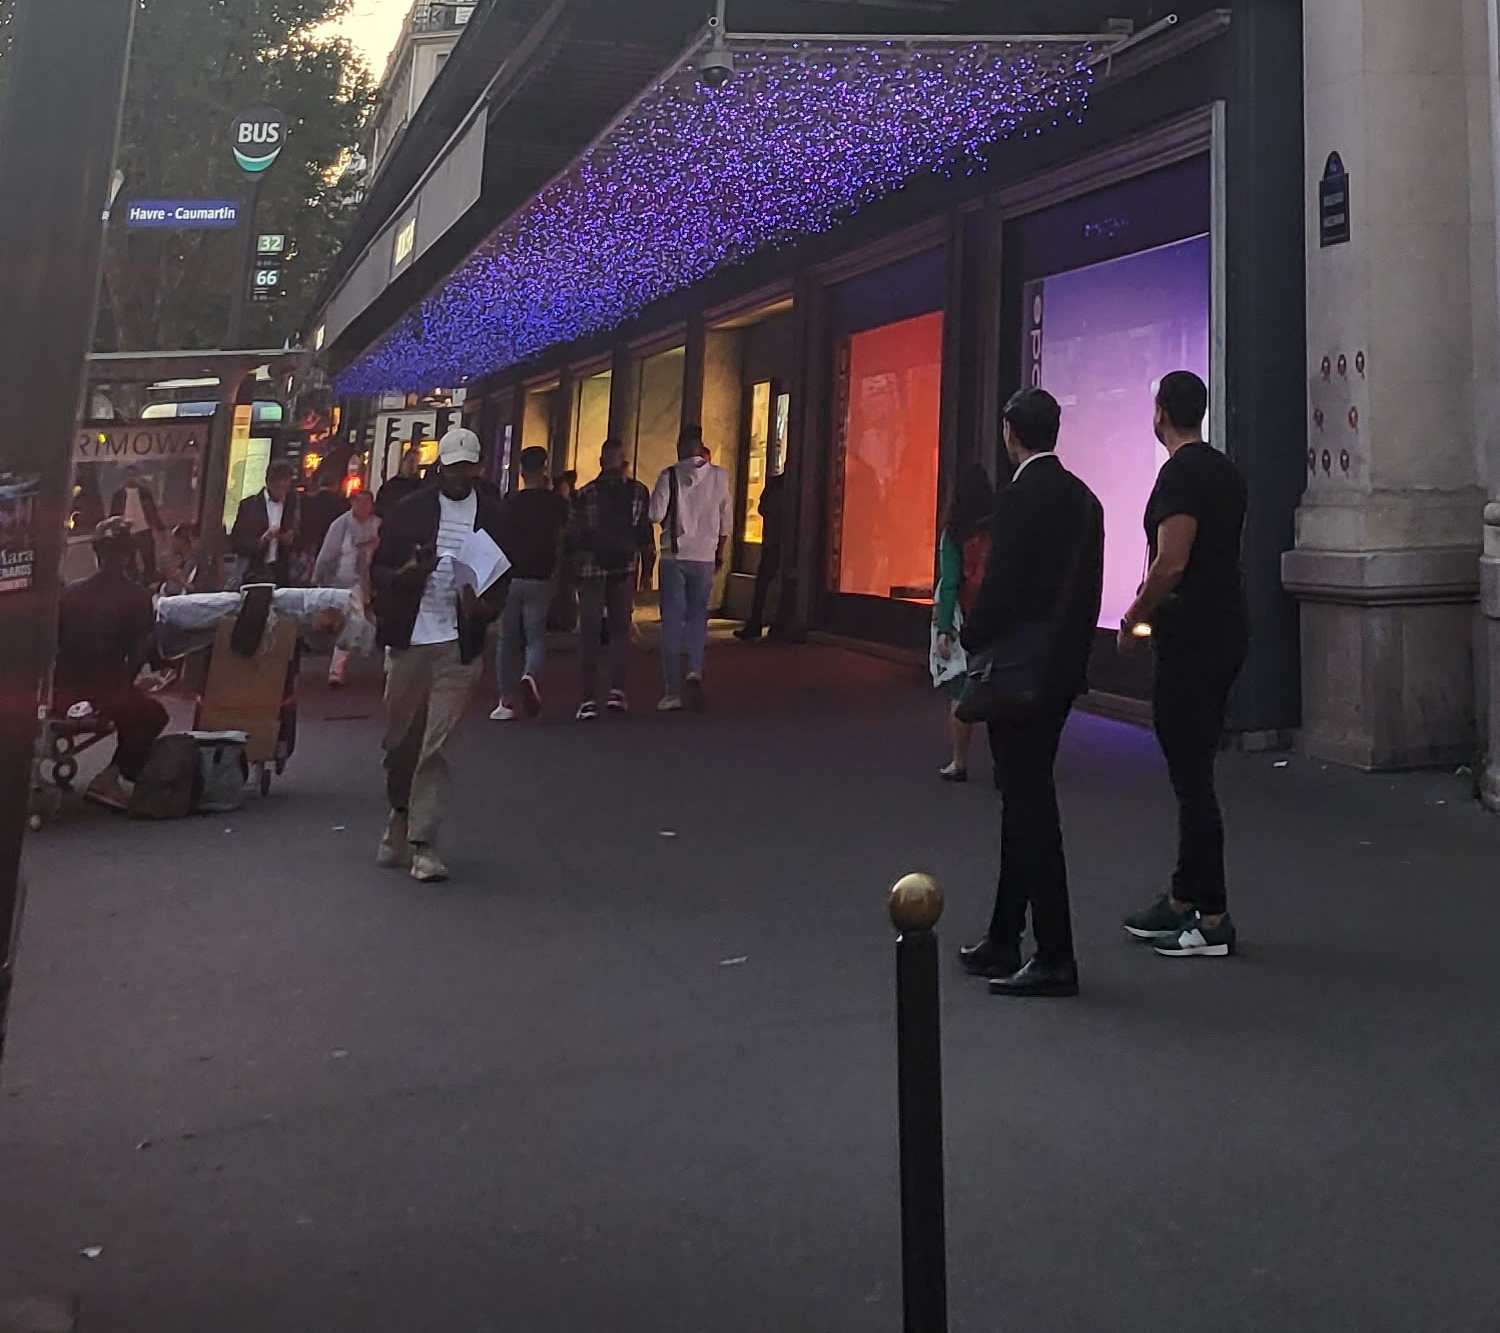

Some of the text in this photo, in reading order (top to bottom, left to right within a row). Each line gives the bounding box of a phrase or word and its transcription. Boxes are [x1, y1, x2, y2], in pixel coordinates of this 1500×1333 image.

[237, 122, 281, 143] BUS
[129, 207, 165, 221] Havre
[174, 206, 236, 221] Caumartin
[260, 236, 281, 251] 32
[256, 270, 277, 286] 66
